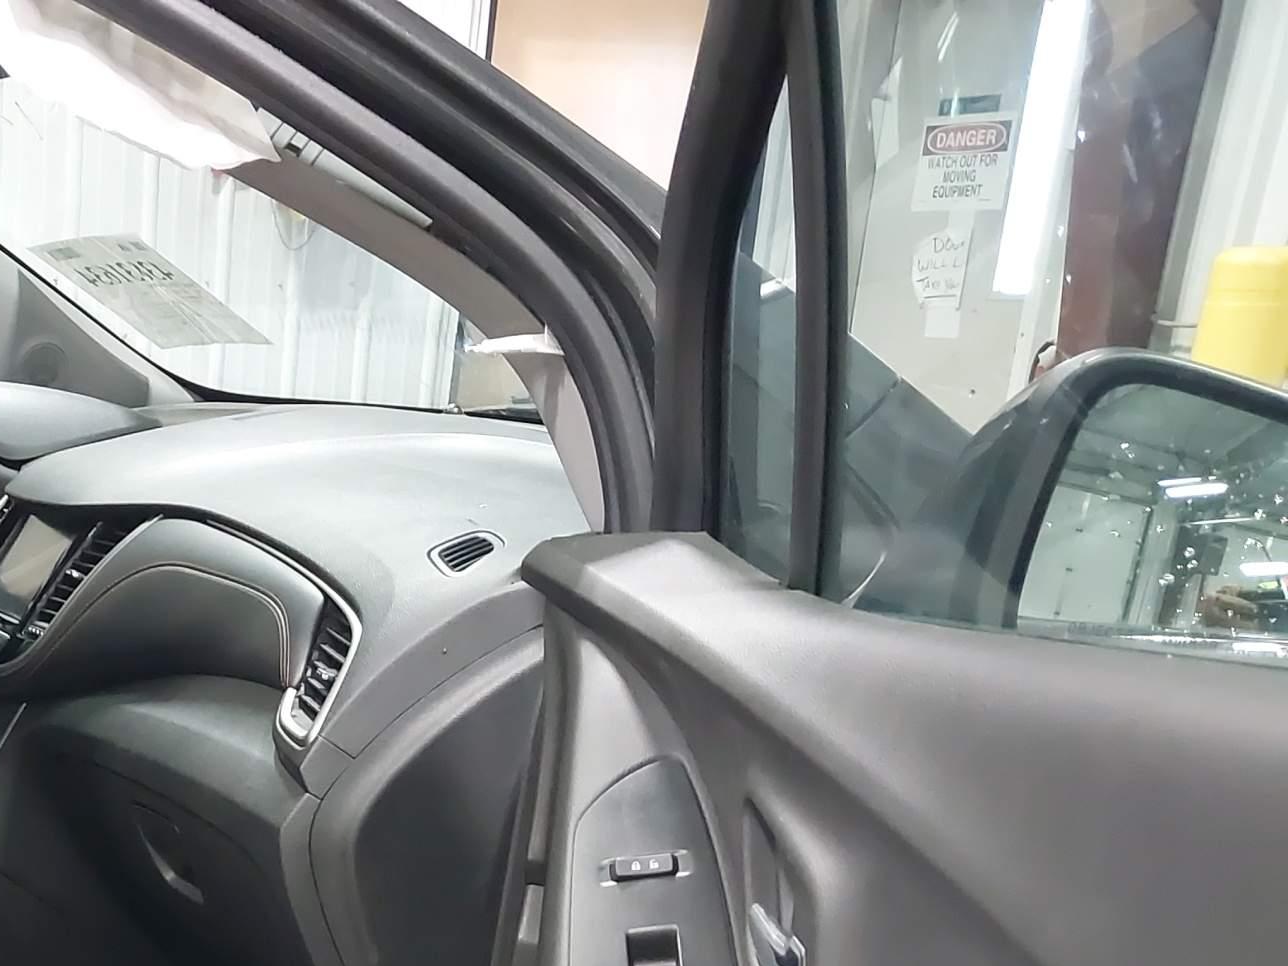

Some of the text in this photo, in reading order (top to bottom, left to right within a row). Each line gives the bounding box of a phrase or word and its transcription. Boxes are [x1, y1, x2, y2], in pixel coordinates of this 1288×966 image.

[936, 128, 997, 149] DANGER
[928, 153, 999, 169] WATCH OUT FOR
[942, 169, 977, 184] MOVING
[932, 183, 983, 199] EQUIPMENT
